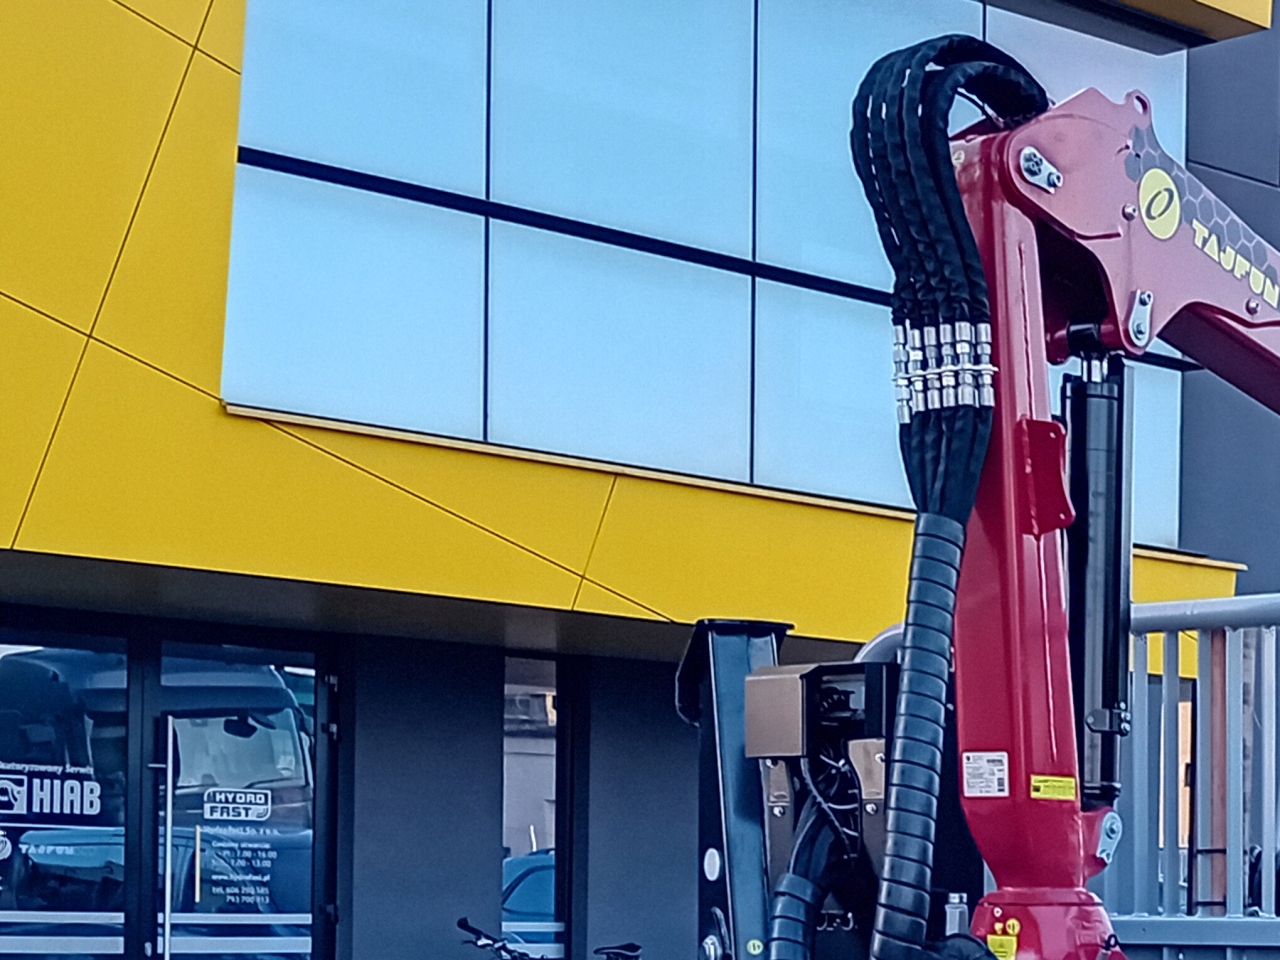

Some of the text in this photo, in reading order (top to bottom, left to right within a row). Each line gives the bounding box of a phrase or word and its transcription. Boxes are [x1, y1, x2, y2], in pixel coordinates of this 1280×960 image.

[1192, 218, 1280, 309] TAJFUN
[32, 778, 101, 815] HIAB
[215, 792, 266, 804] HYDRO
[209, 805, 252, 818] FAST
